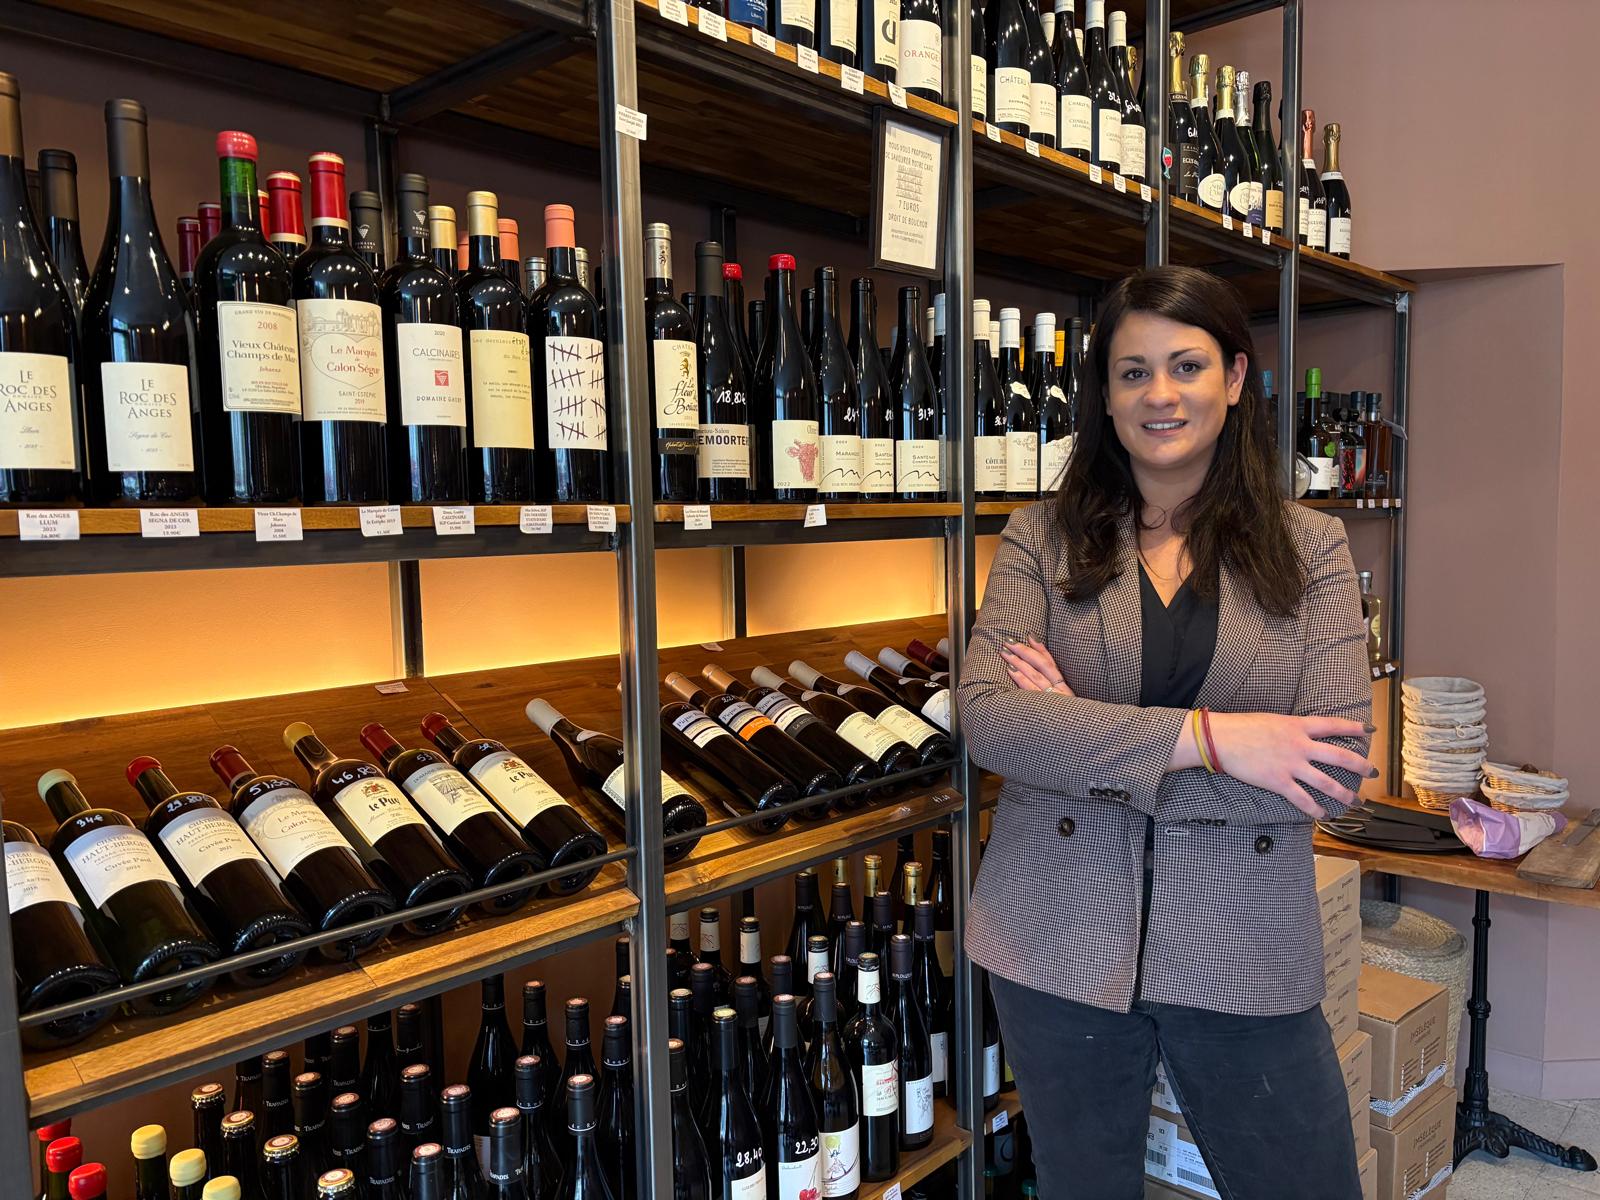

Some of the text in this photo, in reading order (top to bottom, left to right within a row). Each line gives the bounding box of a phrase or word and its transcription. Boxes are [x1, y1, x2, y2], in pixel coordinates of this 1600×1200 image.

[903, 200, 920, 213] EUROS
[232, 340, 261, 349] Vieux
[226, 350, 270, 361] Champs
[271, 353, 283, 361] de
[330, 344, 377, 359] Le Marquis
[412, 347, 461, 360] CALCINAIRES
[326, 362, 356, 373] Calon
[20, 370, 33, 384] LE
[141, 379, 155, 391] LE
[33, 385, 57, 399] DES
[120, 391, 177, 405] ROC DES
[5, 399, 53, 413] ANGES
[127, 406, 172, 419] ANGES
[368, 797, 401, 812] le Puy
[280, 820, 308, 834] Calon
[198, 840, 223, 853] Cuvée
[104, 859, 131, 872] Cuvée
[794, 1136, 819, 1155] 22,30
[735, 1147, 763, 1169] 28,40
